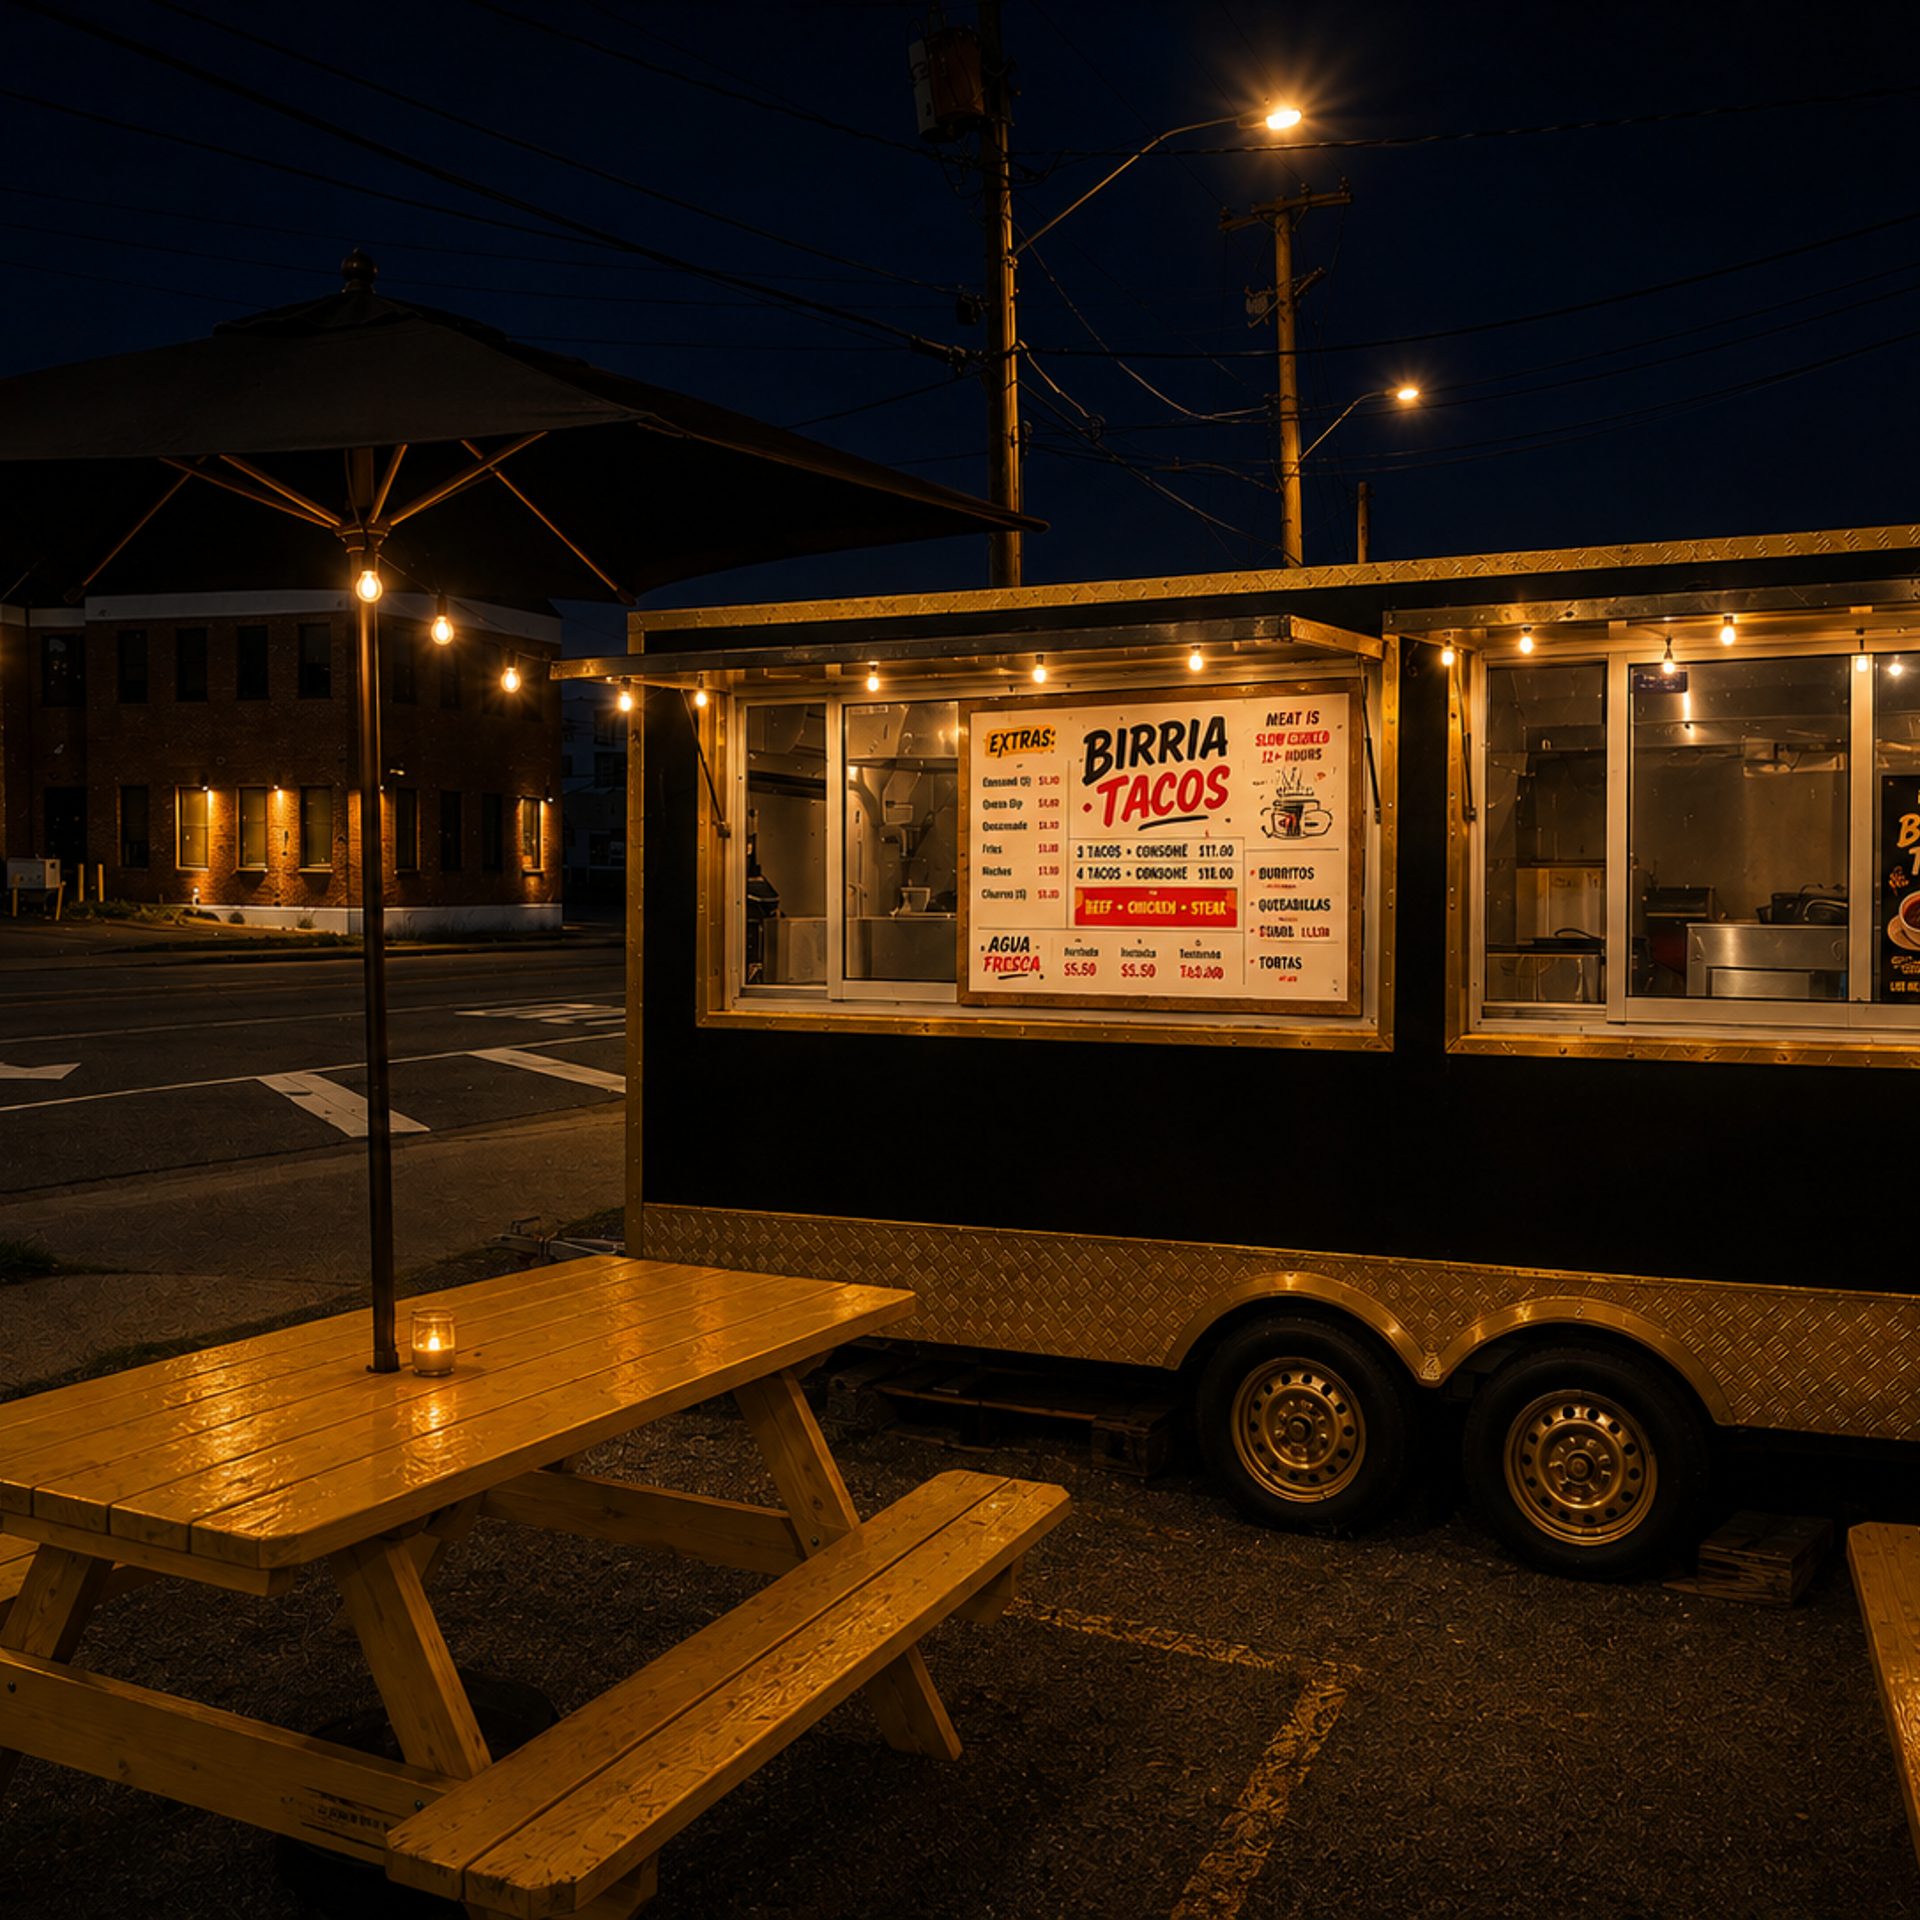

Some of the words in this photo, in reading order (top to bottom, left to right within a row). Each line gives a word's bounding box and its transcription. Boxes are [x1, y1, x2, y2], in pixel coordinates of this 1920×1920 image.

[1266, 711, 1302, 727] MEAT
[1306, 710, 1320, 725] IS
[1082, 716, 1228, 786] BIRRIA
[1096, 765, 1230, 827] TACOS
[1087, 845, 1122, 858] TACOS
[1076, 867, 1083, 880] 4
[1087, 867, 1122, 880] TACOS
[1259, 867, 1315, 880] BURRITOS
[1190, 901, 1226, 916] STEAK
[988, 936, 1030, 953] AGUA
[983, 955, 1041, 973] FRESCA
[1259, 956, 1302, 969] TORTAS
